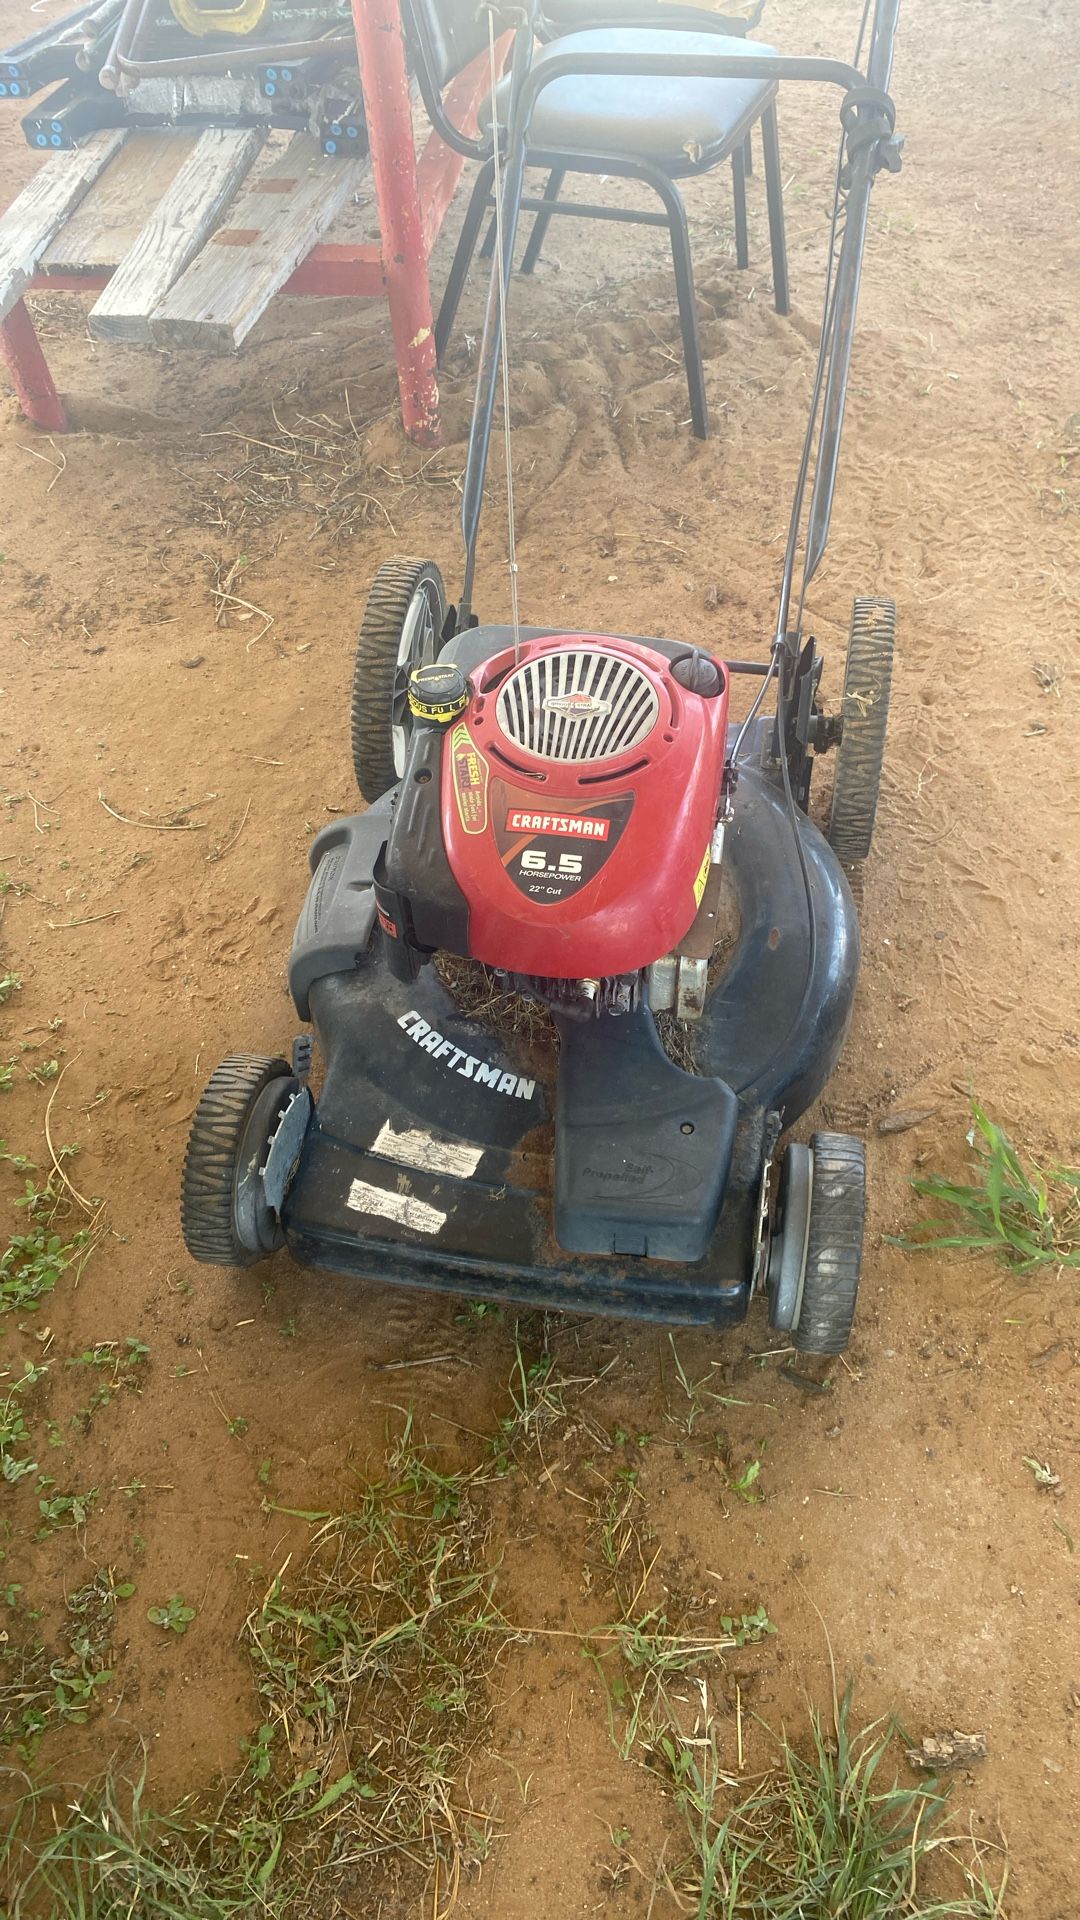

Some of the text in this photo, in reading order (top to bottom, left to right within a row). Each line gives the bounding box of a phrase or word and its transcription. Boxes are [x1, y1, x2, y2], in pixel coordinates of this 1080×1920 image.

[457, 759, 471, 790] START
[467, 752, 480, 786] FRESH
[511, 814, 605, 836] CRAFTSMAN
[520, 849, 583, 874] 6.5
[519, 869, 582, 882] HORSEPOWER
[528, 885, 562, 895] 22" Cut
[397, 1010, 536, 1100] CRAFTSMAN
